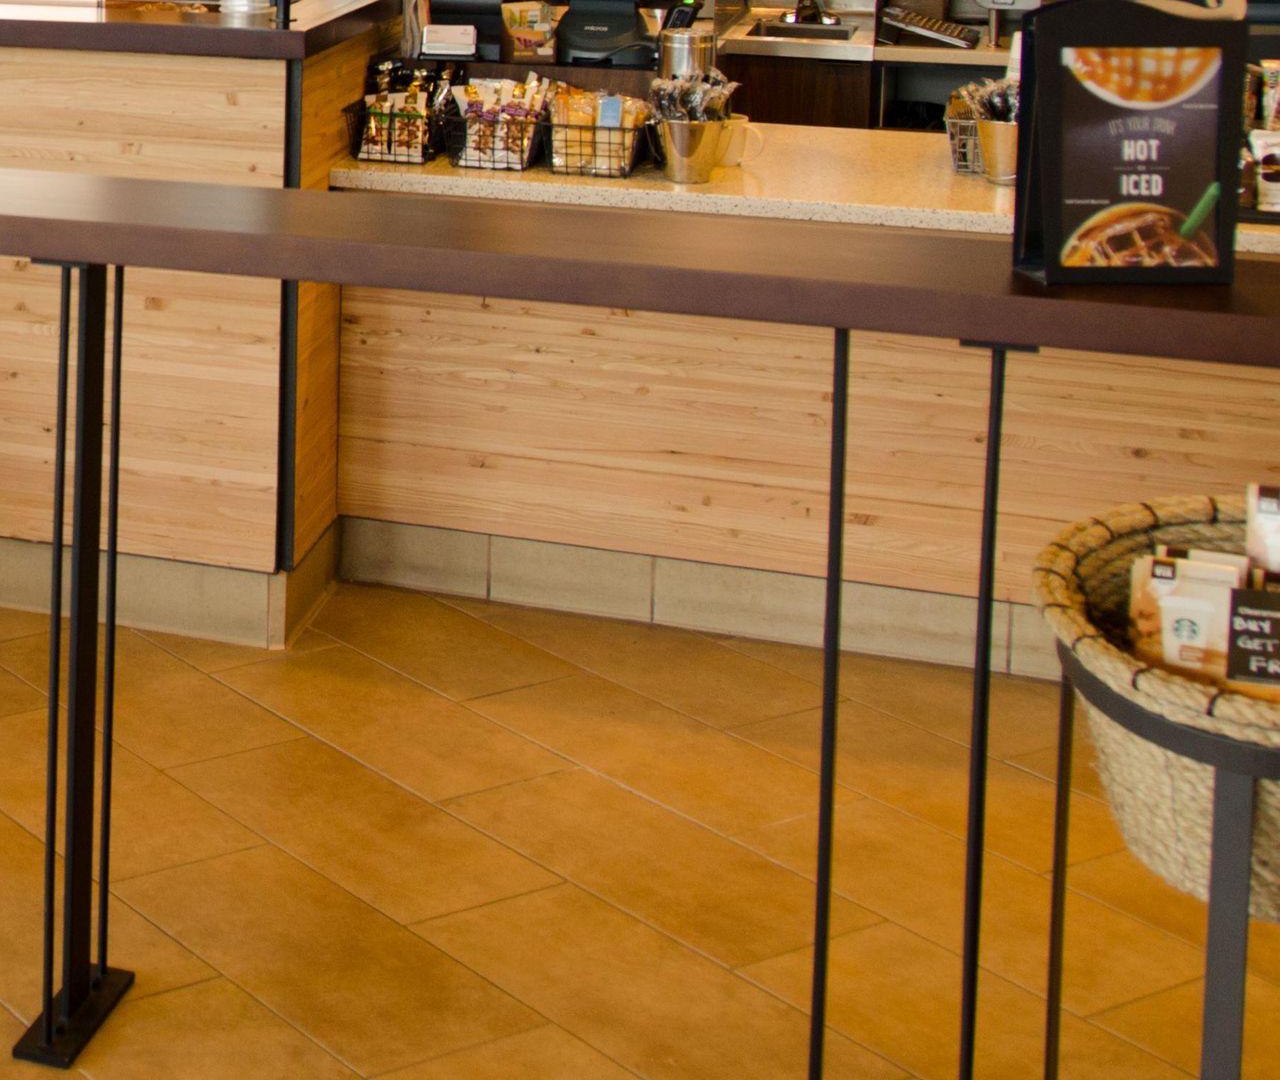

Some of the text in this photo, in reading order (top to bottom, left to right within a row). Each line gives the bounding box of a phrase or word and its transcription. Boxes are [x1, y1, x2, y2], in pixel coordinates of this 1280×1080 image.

[1120, 138, 1161, 162] HOT
[1119, 173, 1164, 196] ICED
[1153, 564, 1174, 578] VIA
[1247, 655, 1280, 675] FR
